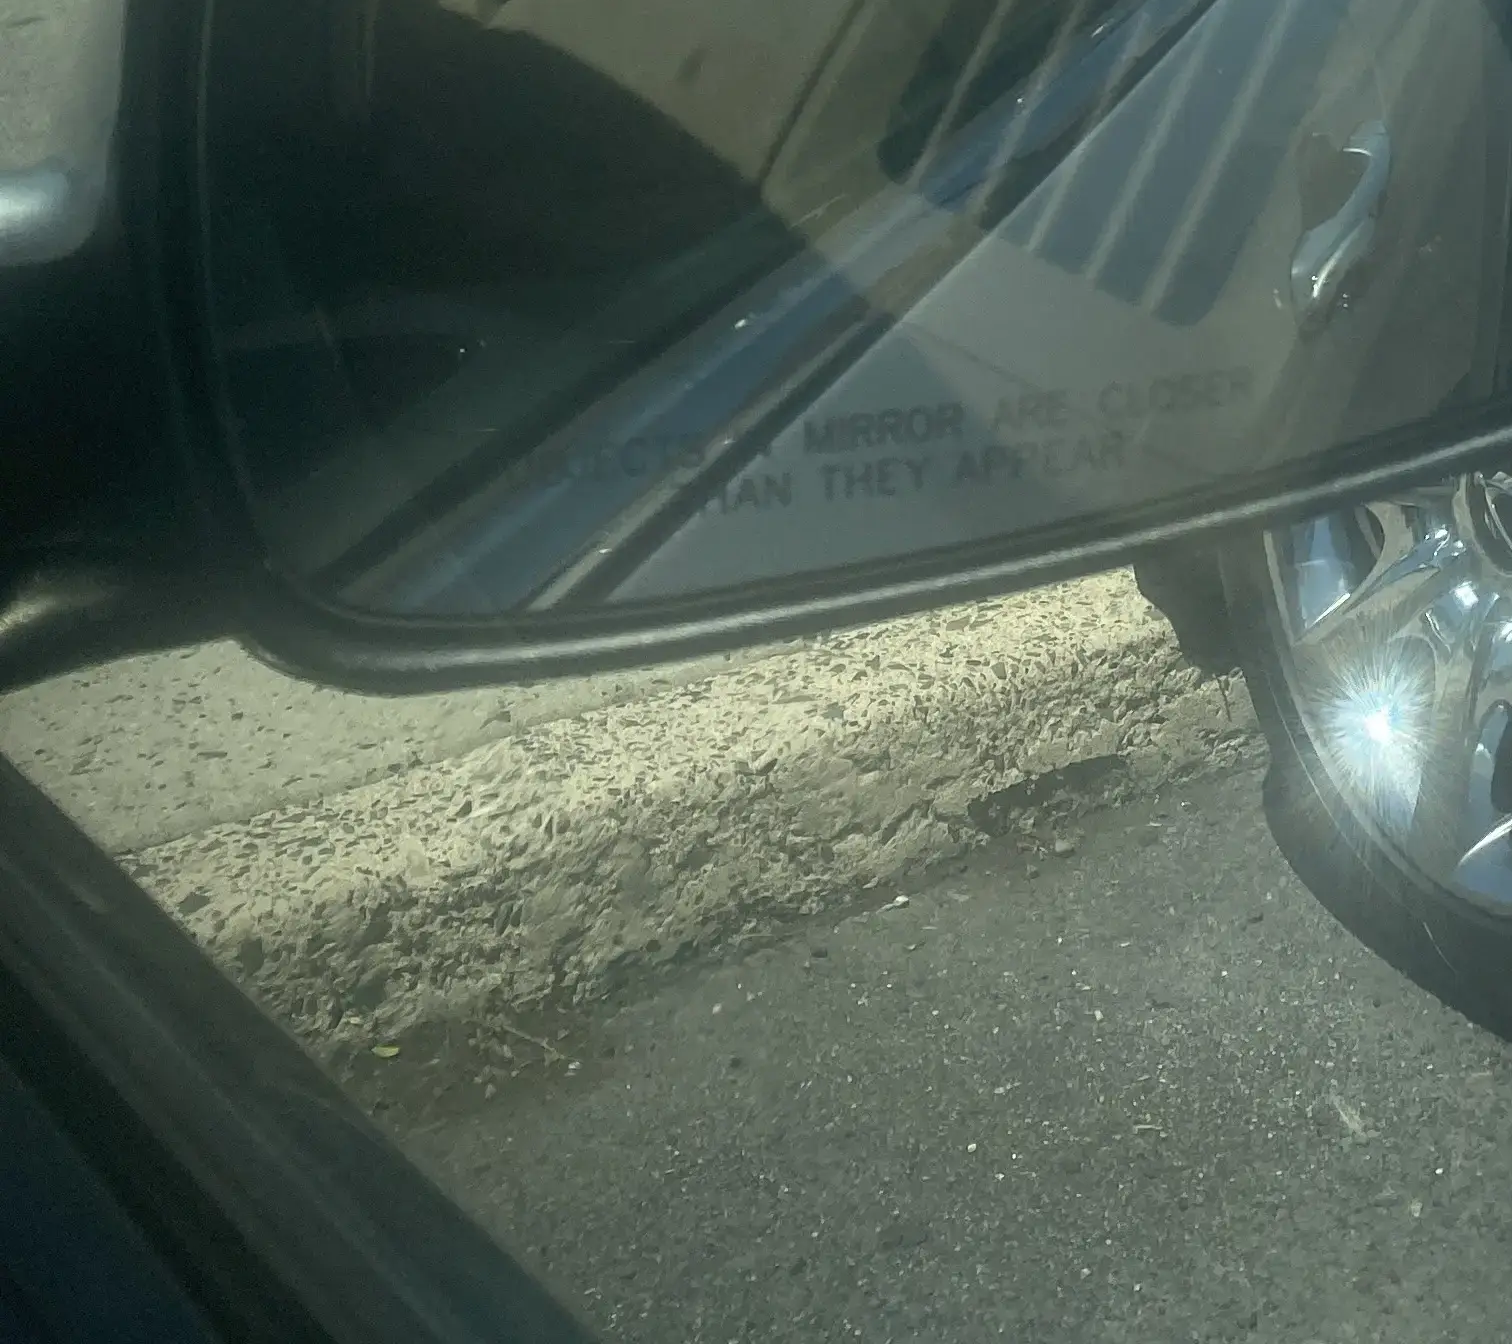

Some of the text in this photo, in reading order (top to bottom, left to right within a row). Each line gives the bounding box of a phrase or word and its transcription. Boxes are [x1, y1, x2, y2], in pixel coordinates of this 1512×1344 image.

[802, 402, 963, 454] MIRROR
[991, 389, 1067, 432] ARE
[1098, 366, 1254, 416] CLOSER
[708, 429, 1124, 514] AN THEY APPEAR
